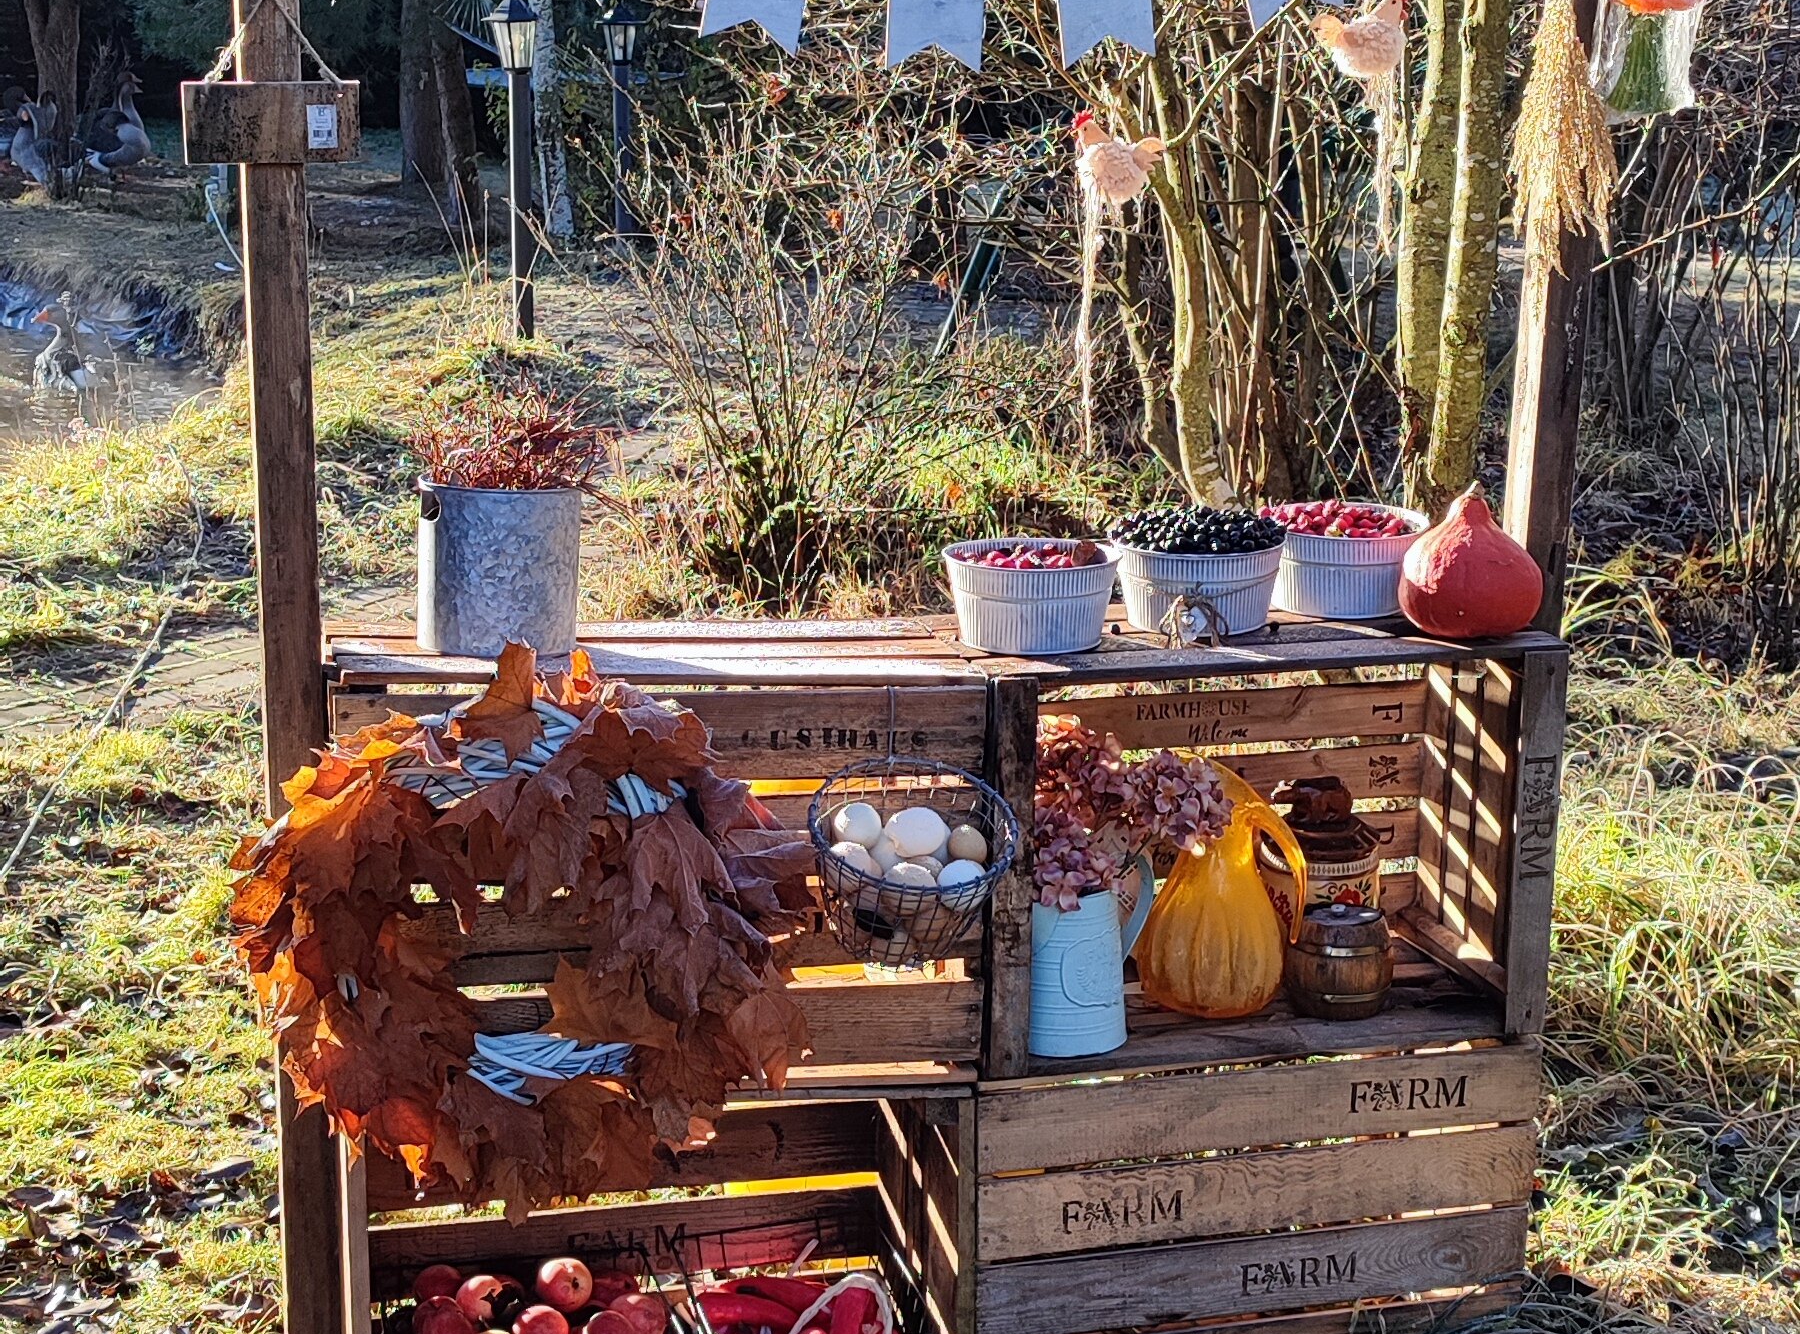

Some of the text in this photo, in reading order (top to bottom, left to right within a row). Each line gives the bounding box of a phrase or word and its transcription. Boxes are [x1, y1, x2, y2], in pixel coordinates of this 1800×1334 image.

[1519, 754, 1557, 881] FARM
[1350, 1074, 1469, 1114] FARM
[1061, 1189, 1184, 1235] FARM
[1240, 1251, 1357, 1296] FARM
